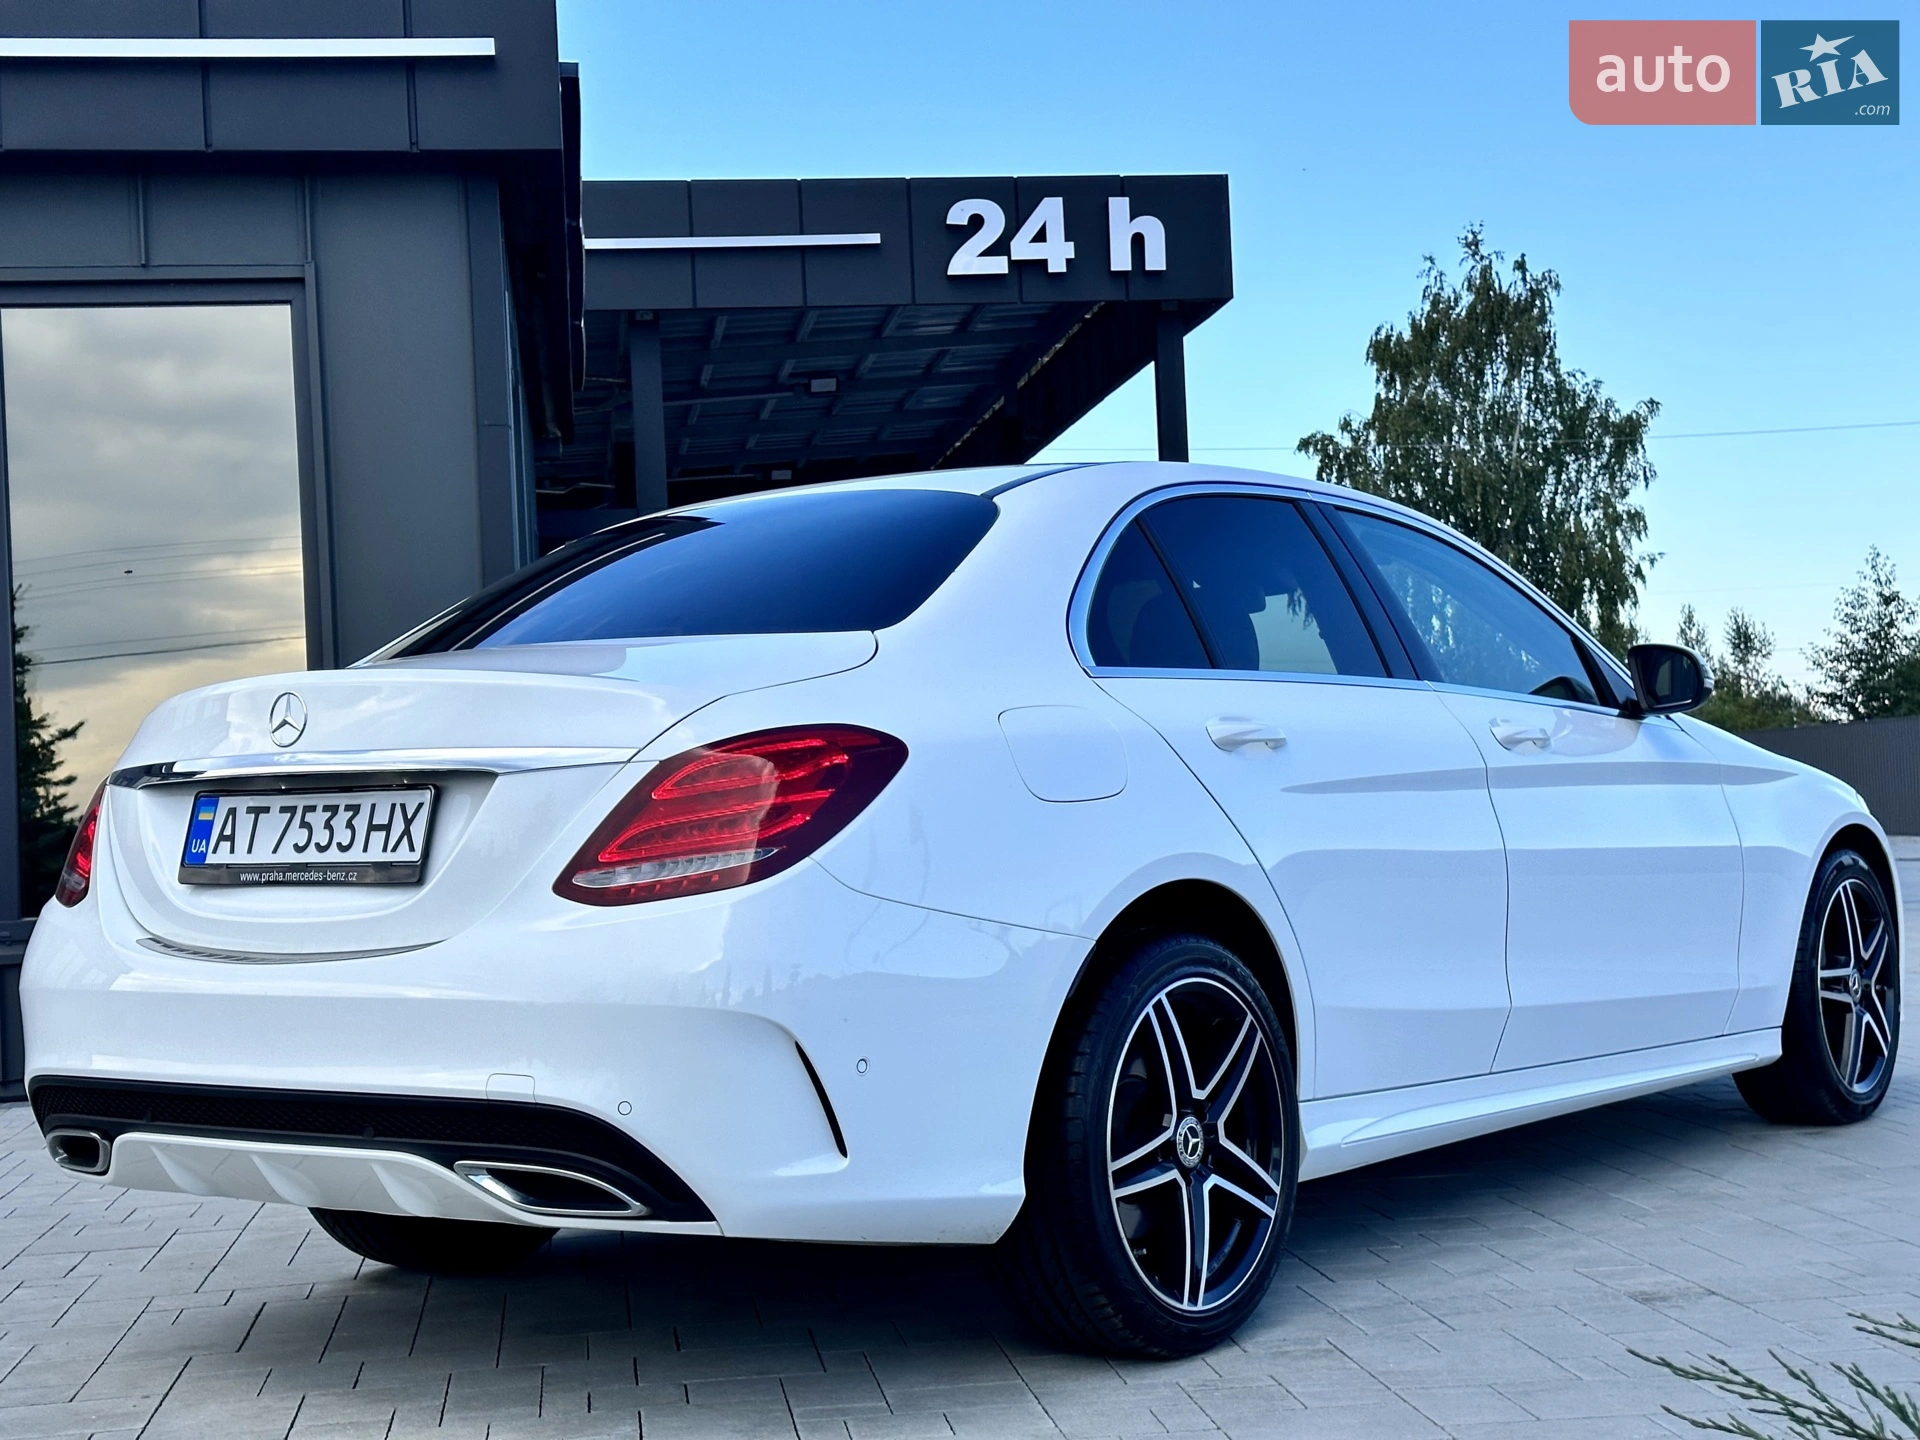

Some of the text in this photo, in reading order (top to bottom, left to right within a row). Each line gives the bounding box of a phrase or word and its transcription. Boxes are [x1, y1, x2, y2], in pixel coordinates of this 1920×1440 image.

[946, 196, 1167, 275] 24 h
[191, 838, 206, 853] UA
[240, 869, 358, 884] www.praha.mercedes-benz.cz
